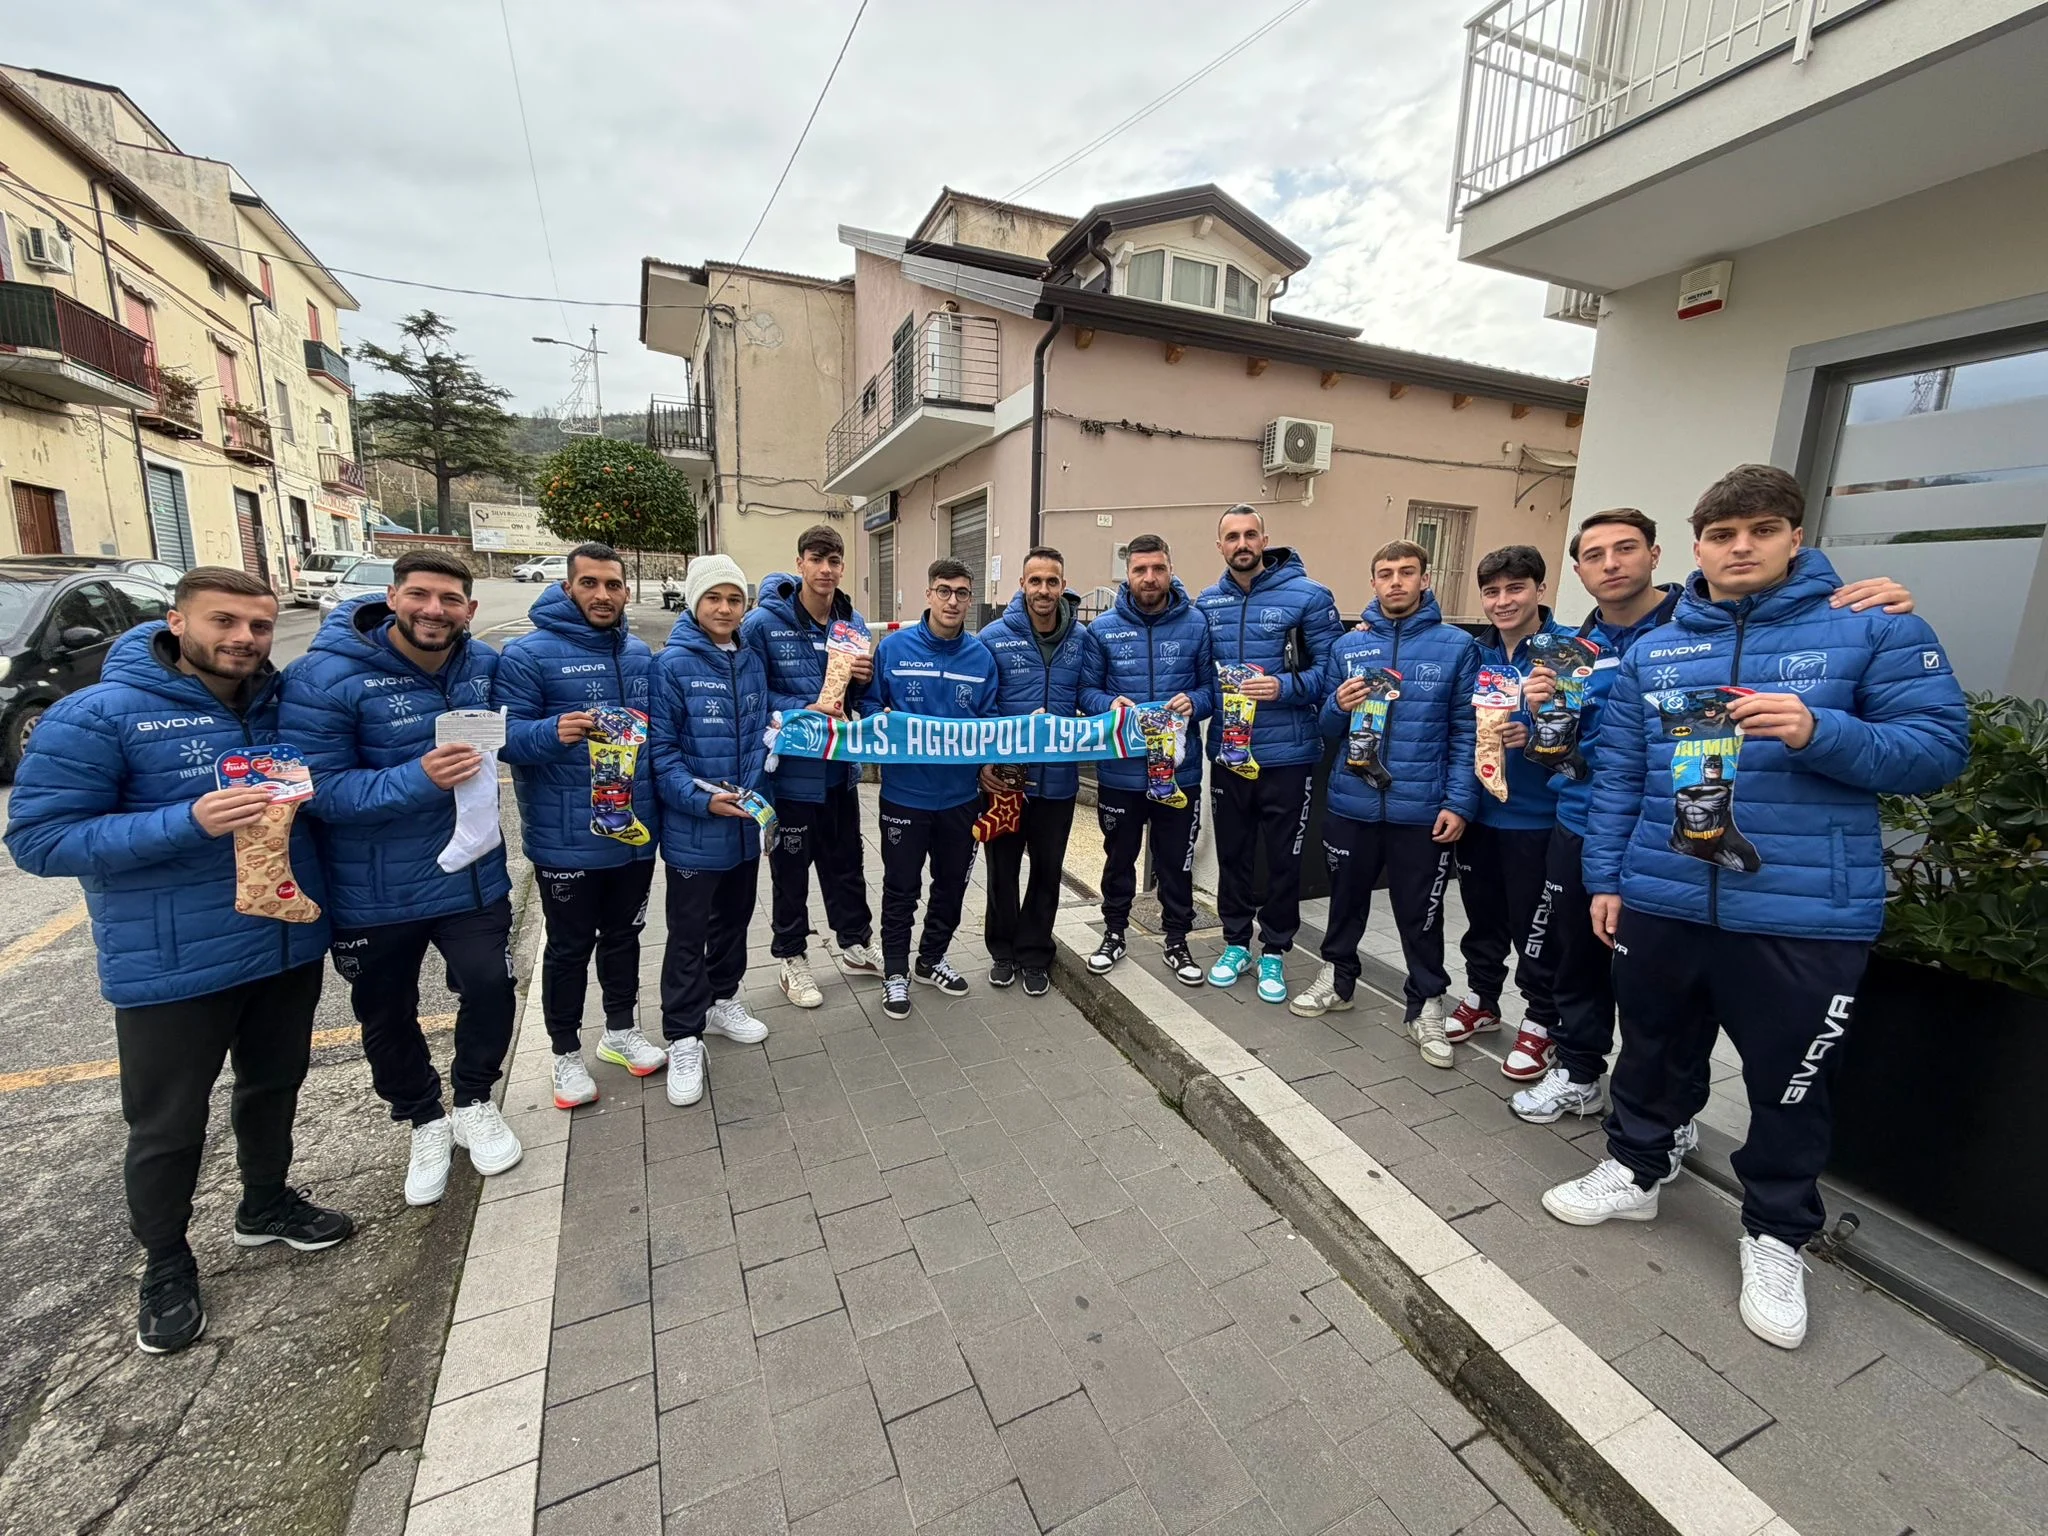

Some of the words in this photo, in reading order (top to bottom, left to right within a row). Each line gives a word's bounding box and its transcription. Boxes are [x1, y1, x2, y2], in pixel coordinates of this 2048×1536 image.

[1105, 631, 1138, 639] GIVOVA
[995, 640, 1028, 648] GIVOVA
[1344, 648, 1380, 659] GIVOVA
[1650, 643, 1712, 658] GIVOVA
[561, 663, 606, 674] GIVOVA
[899, 660, 934, 668] GIVOVA
[363, 675, 415, 688] GIVOVA
[690, 680, 727, 690] GIVOVA
[1668, 698, 1682, 707] DC
[137, 716, 214, 732] GIVOVA
[846, 714, 897, 756] U.S.
[907, 716, 1035, 757] AGROPOLI
[1044, 715, 1107, 753] 1921
[180, 765, 216, 779] INFANT
[881, 814, 911, 825] GIVOVA
[1292, 776, 1313, 855] GIVOVA
[1182, 799, 1200, 872] GIVOVA
[541, 870, 585, 880] GIVOVA
[1422, 851, 1450, 932] GIVOVA
[1779, 994, 1855, 1105] GIVOVA
